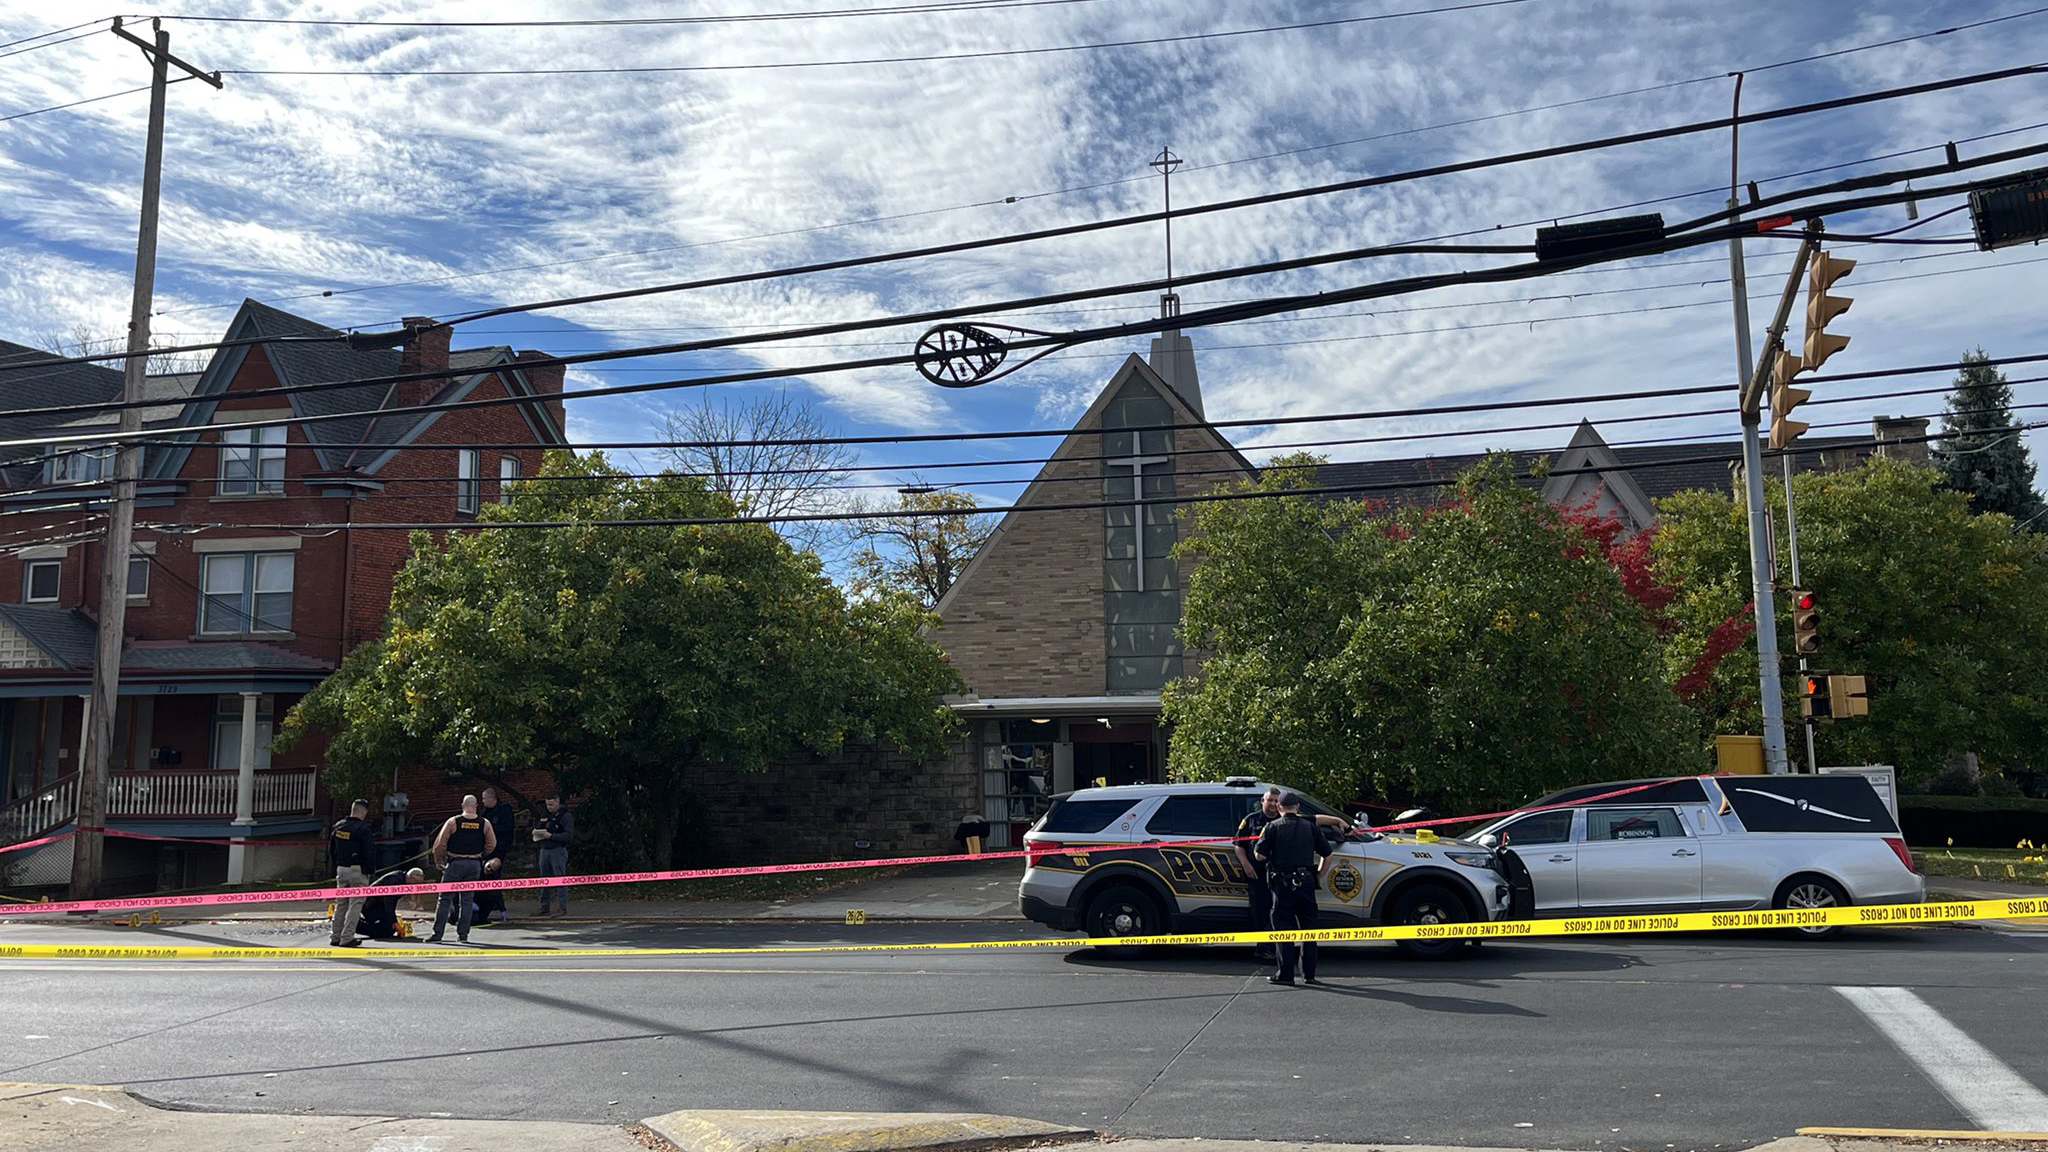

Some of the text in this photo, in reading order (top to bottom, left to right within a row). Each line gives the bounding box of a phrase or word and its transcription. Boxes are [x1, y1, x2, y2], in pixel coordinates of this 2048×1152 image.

[1411, 851, 1433, 859] 3121
[1159, 848, 1248, 885] POL
[1192, 885, 1248, 896] PITTS
[1860, 905, 1974, 921] POLICE LINE DO NOT CROSS
[2008, 900, 2048, 914] OT CROSS
[1564, 918, 1678, 932] POLICE LINE DO NOT CROSS
[1712, 911, 1826, 926] POLICE LINE DO NOT CROSS
[1416, 924, 1530, 937] POLICE LINE DO NOT CROSS
